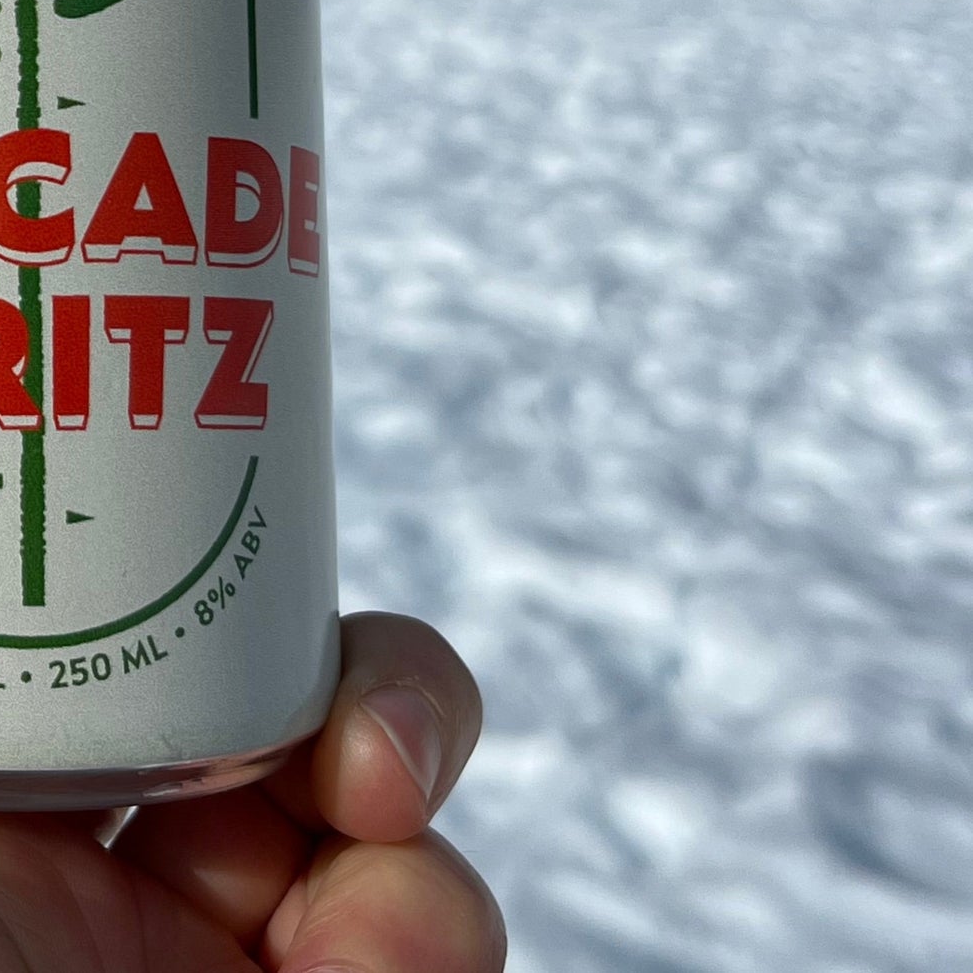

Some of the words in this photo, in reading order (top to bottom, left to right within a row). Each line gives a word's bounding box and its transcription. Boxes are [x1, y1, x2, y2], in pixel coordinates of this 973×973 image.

[49, 653, 112, 689] 250
[122, 635, 168, 674] ML
[194, 576, 236, 625] 8%
[233, 506, 268, 579] ABV
